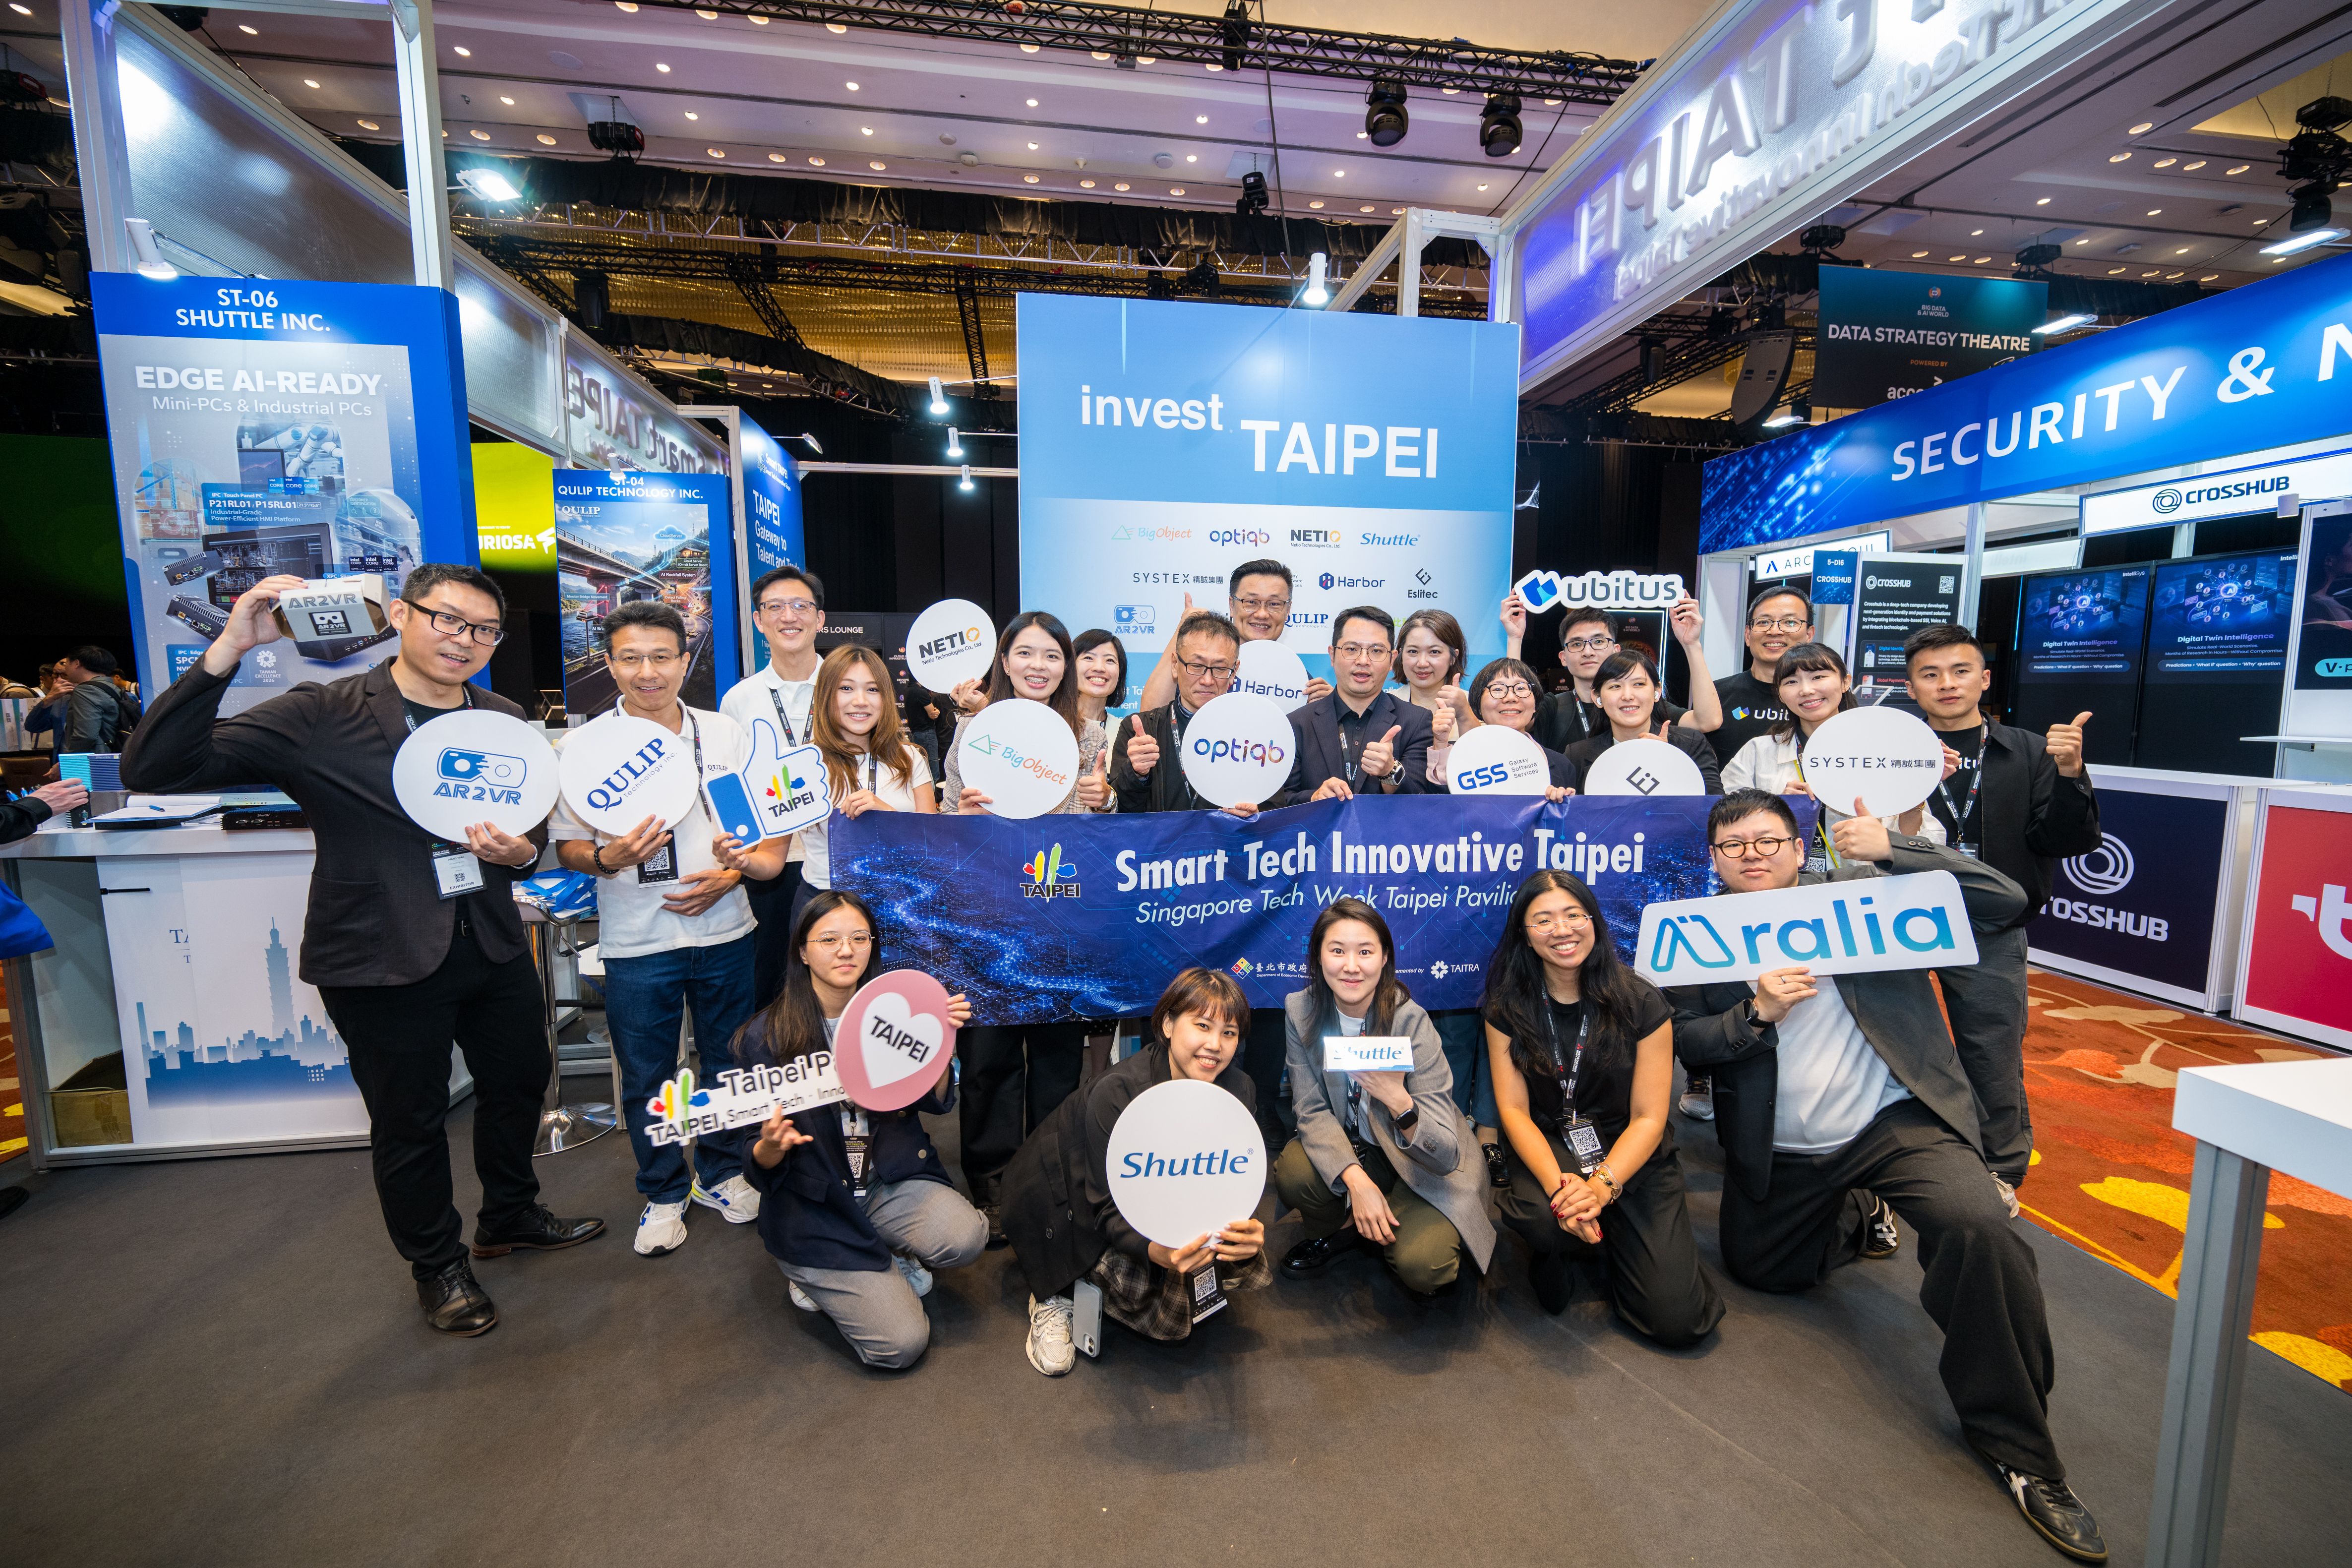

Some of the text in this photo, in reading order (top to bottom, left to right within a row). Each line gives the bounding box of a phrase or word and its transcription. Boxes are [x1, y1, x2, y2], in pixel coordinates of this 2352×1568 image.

[217, 288, 279, 308] ST-06
[176, 308, 330, 332] SHUTTLE INC.
[1828, 324, 2031, 352] DATA STRATEGY THEATRE
[135, 365, 382, 396] EDGE AI-READY
[152, 396, 372, 417] Mini-PCs & Industrial PCs
[1891, 364, 2188, 482] SECURITY
[2217, 346, 2275, 404] &
[1081, 385, 1438, 479] invest TAIPEI
[777, 463, 788, 480] TAIPEI
[558, 485, 703, 499] QULIP TECHNOLOGY INC.
[561, 505, 601, 516] QULIP
[753, 489, 780, 527] TAIPEI
[755, 520, 787, 551] Gateway to
[1138, 527, 1192, 542] BigObject
[1209, 528, 1270, 547] optiqb
[756, 543, 775, 567] Talent
[1133, 573, 1190, 584] SYSTEX
[1193, 576, 1223, 585] 精誠集團
[1338, 576, 1386, 588] Harbor
[1407, 589, 1438, 600] Eslitec
[1567, 577, 1678, 603] ubitus
[288, 593, 358, 609] AR2VR
[2225, 633, 2274, 642] Intelligence
[935, 648, 965, 661] Technologies
[1245, 680, 1303, 699] Harbor
[1193, 738, 1285, 768] optiqb
[1508, 758, 1528, 766] Galaxy
[1809, 757, 1887, 769] SYSTEX
[587, 737, 665, 812] QULIP
[1001, 746, 1069, 785] BigObject
[1511, 762, 1537, 772] Software
[1513, 768, 1539, 779] Services
[1890, 759, 1936, 769] 精誠集團
[623, 764, 664, 799] Technology
[1457, 763, 1508, 790] GSS
[769, 791, 815, 818] TAIPEI
[1117, 829, 1645, 892] Smart Tech Innovative Taipei
[449, 882, 475, 890] EXHIBITOR
[1020, 883, 1081, 900] TAIPEI
[1136, 896, 1252, 928] Singapore
[1261, 882, 1304, 911] Tech
[1386, 884, 1448, 915] Taipei
[2040, 898, 2169, 942] ROSSHUB
[1450, 964, 1479, 973] TAITRA
[870, 1015, 930, 1064] TAIPEI
[723, 1058, 808, 1096] Taipei
[726, 1101, 771, 1123] Smart
[651, 1112, 720, 1143] TAIPEI
